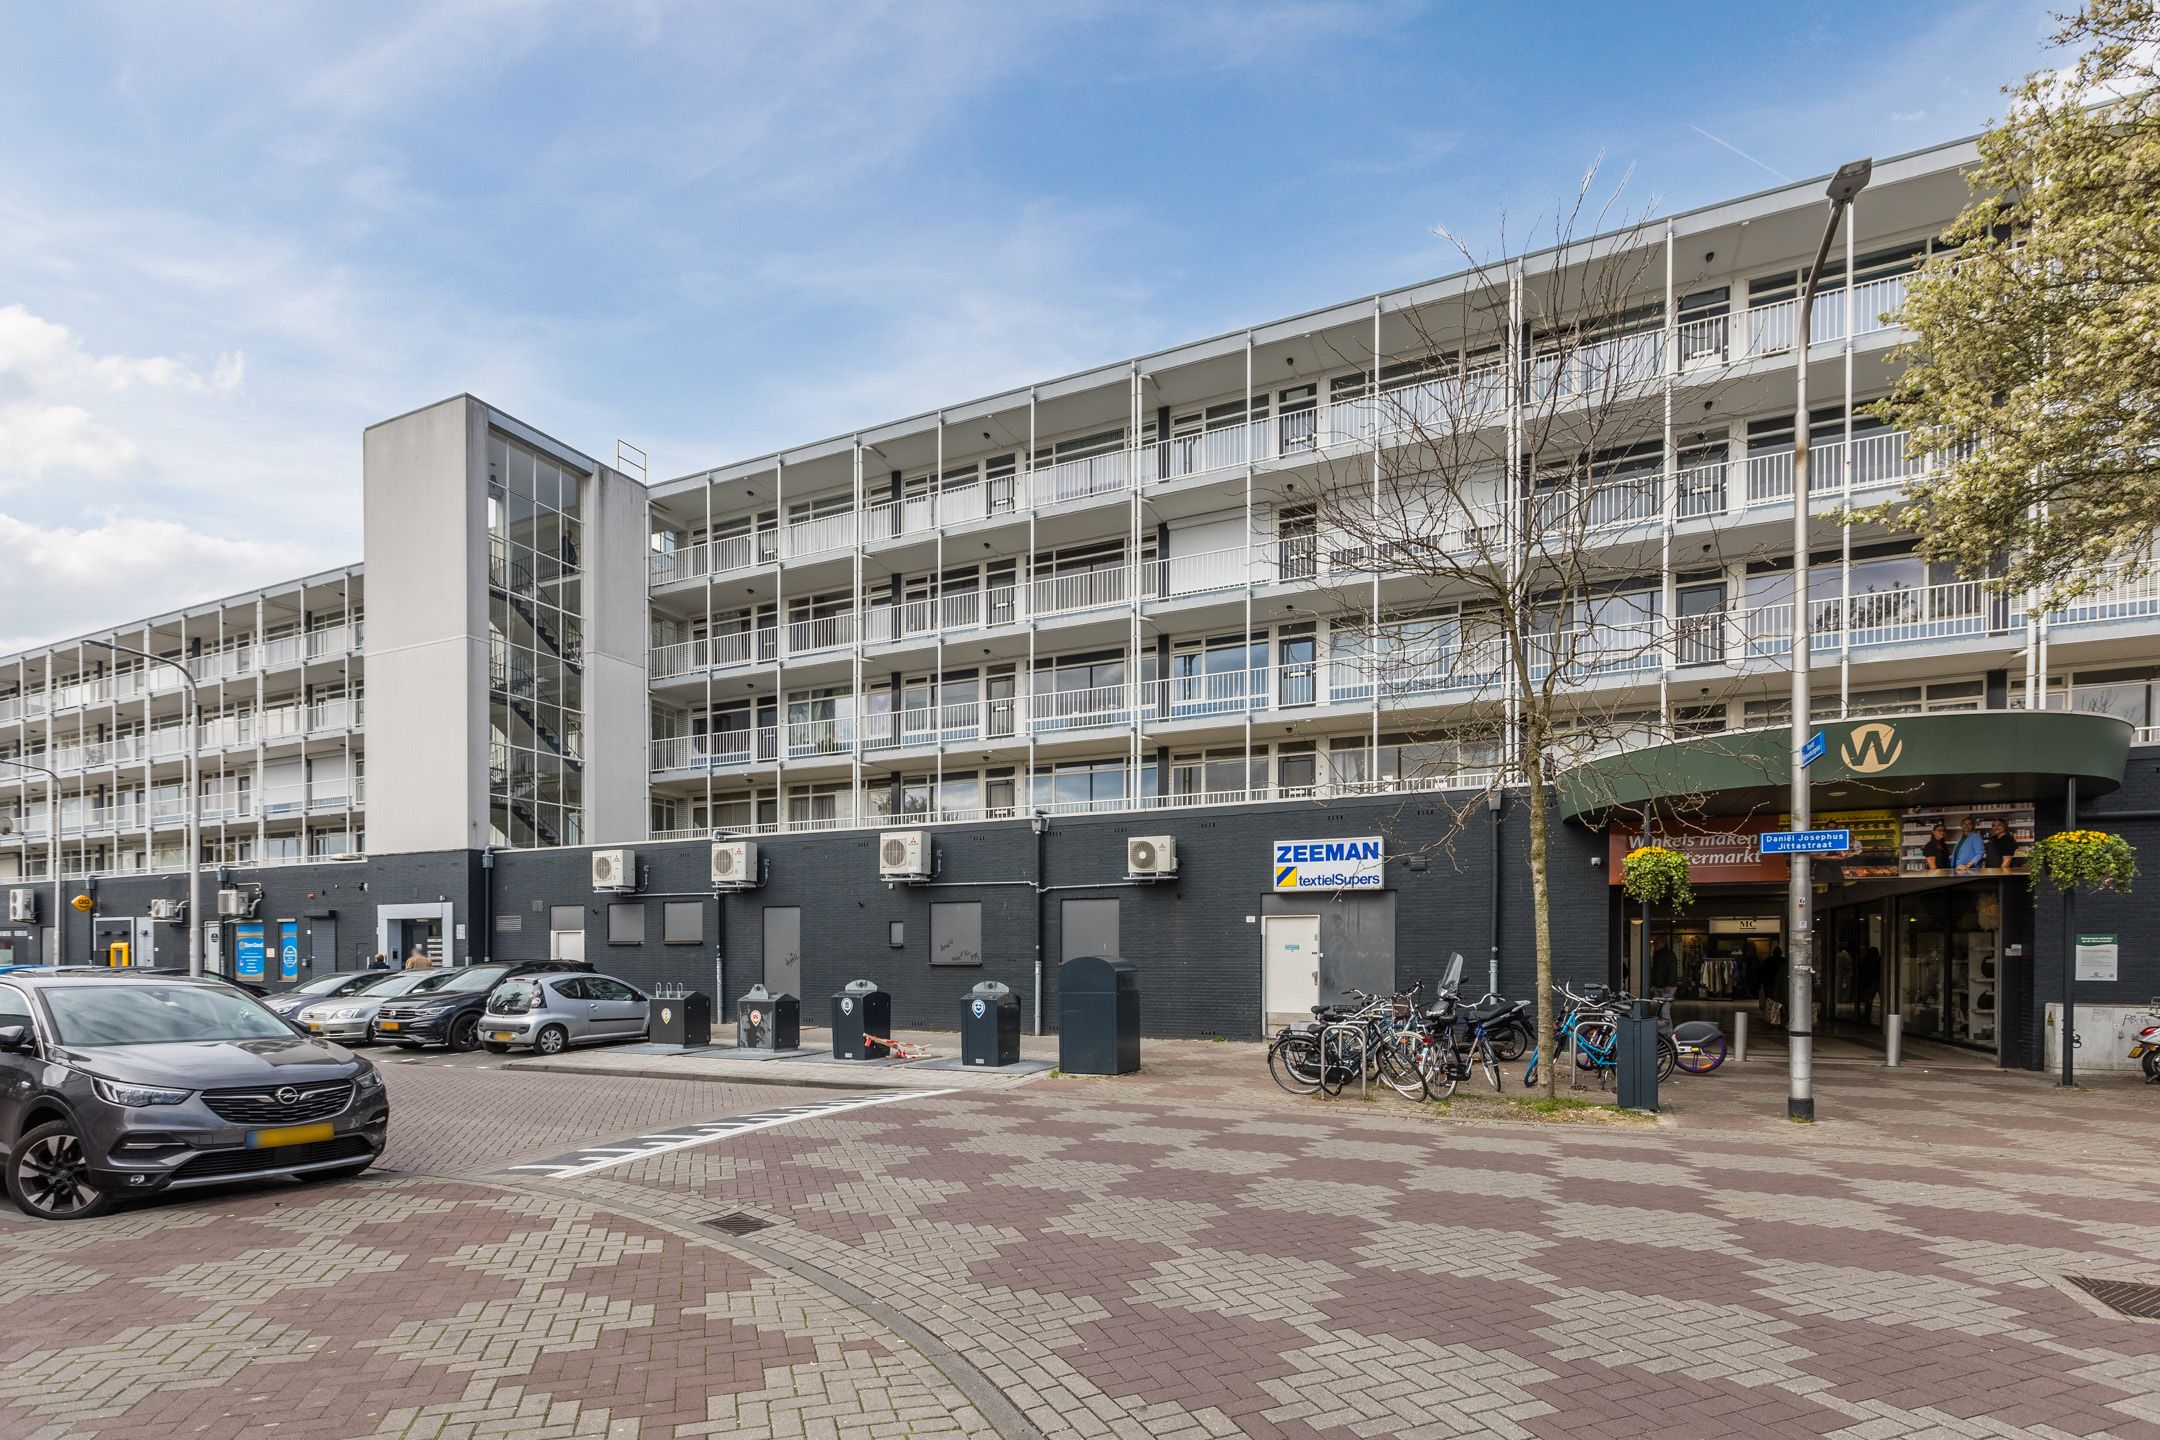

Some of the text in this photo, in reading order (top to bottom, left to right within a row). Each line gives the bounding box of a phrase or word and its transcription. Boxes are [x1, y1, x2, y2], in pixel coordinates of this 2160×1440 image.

[1628, 833, 1758, 849] Wnkels maken
[1766, 833, 1844, 843] Daniël Josephus
[1778, 841, 1833, 850] Jittastraat
[1276, 842, 1379, 863] ZEEMAN
[1298, 873, 1380, 888] textielSupers
[1739, 920, 1757, 928] MC
